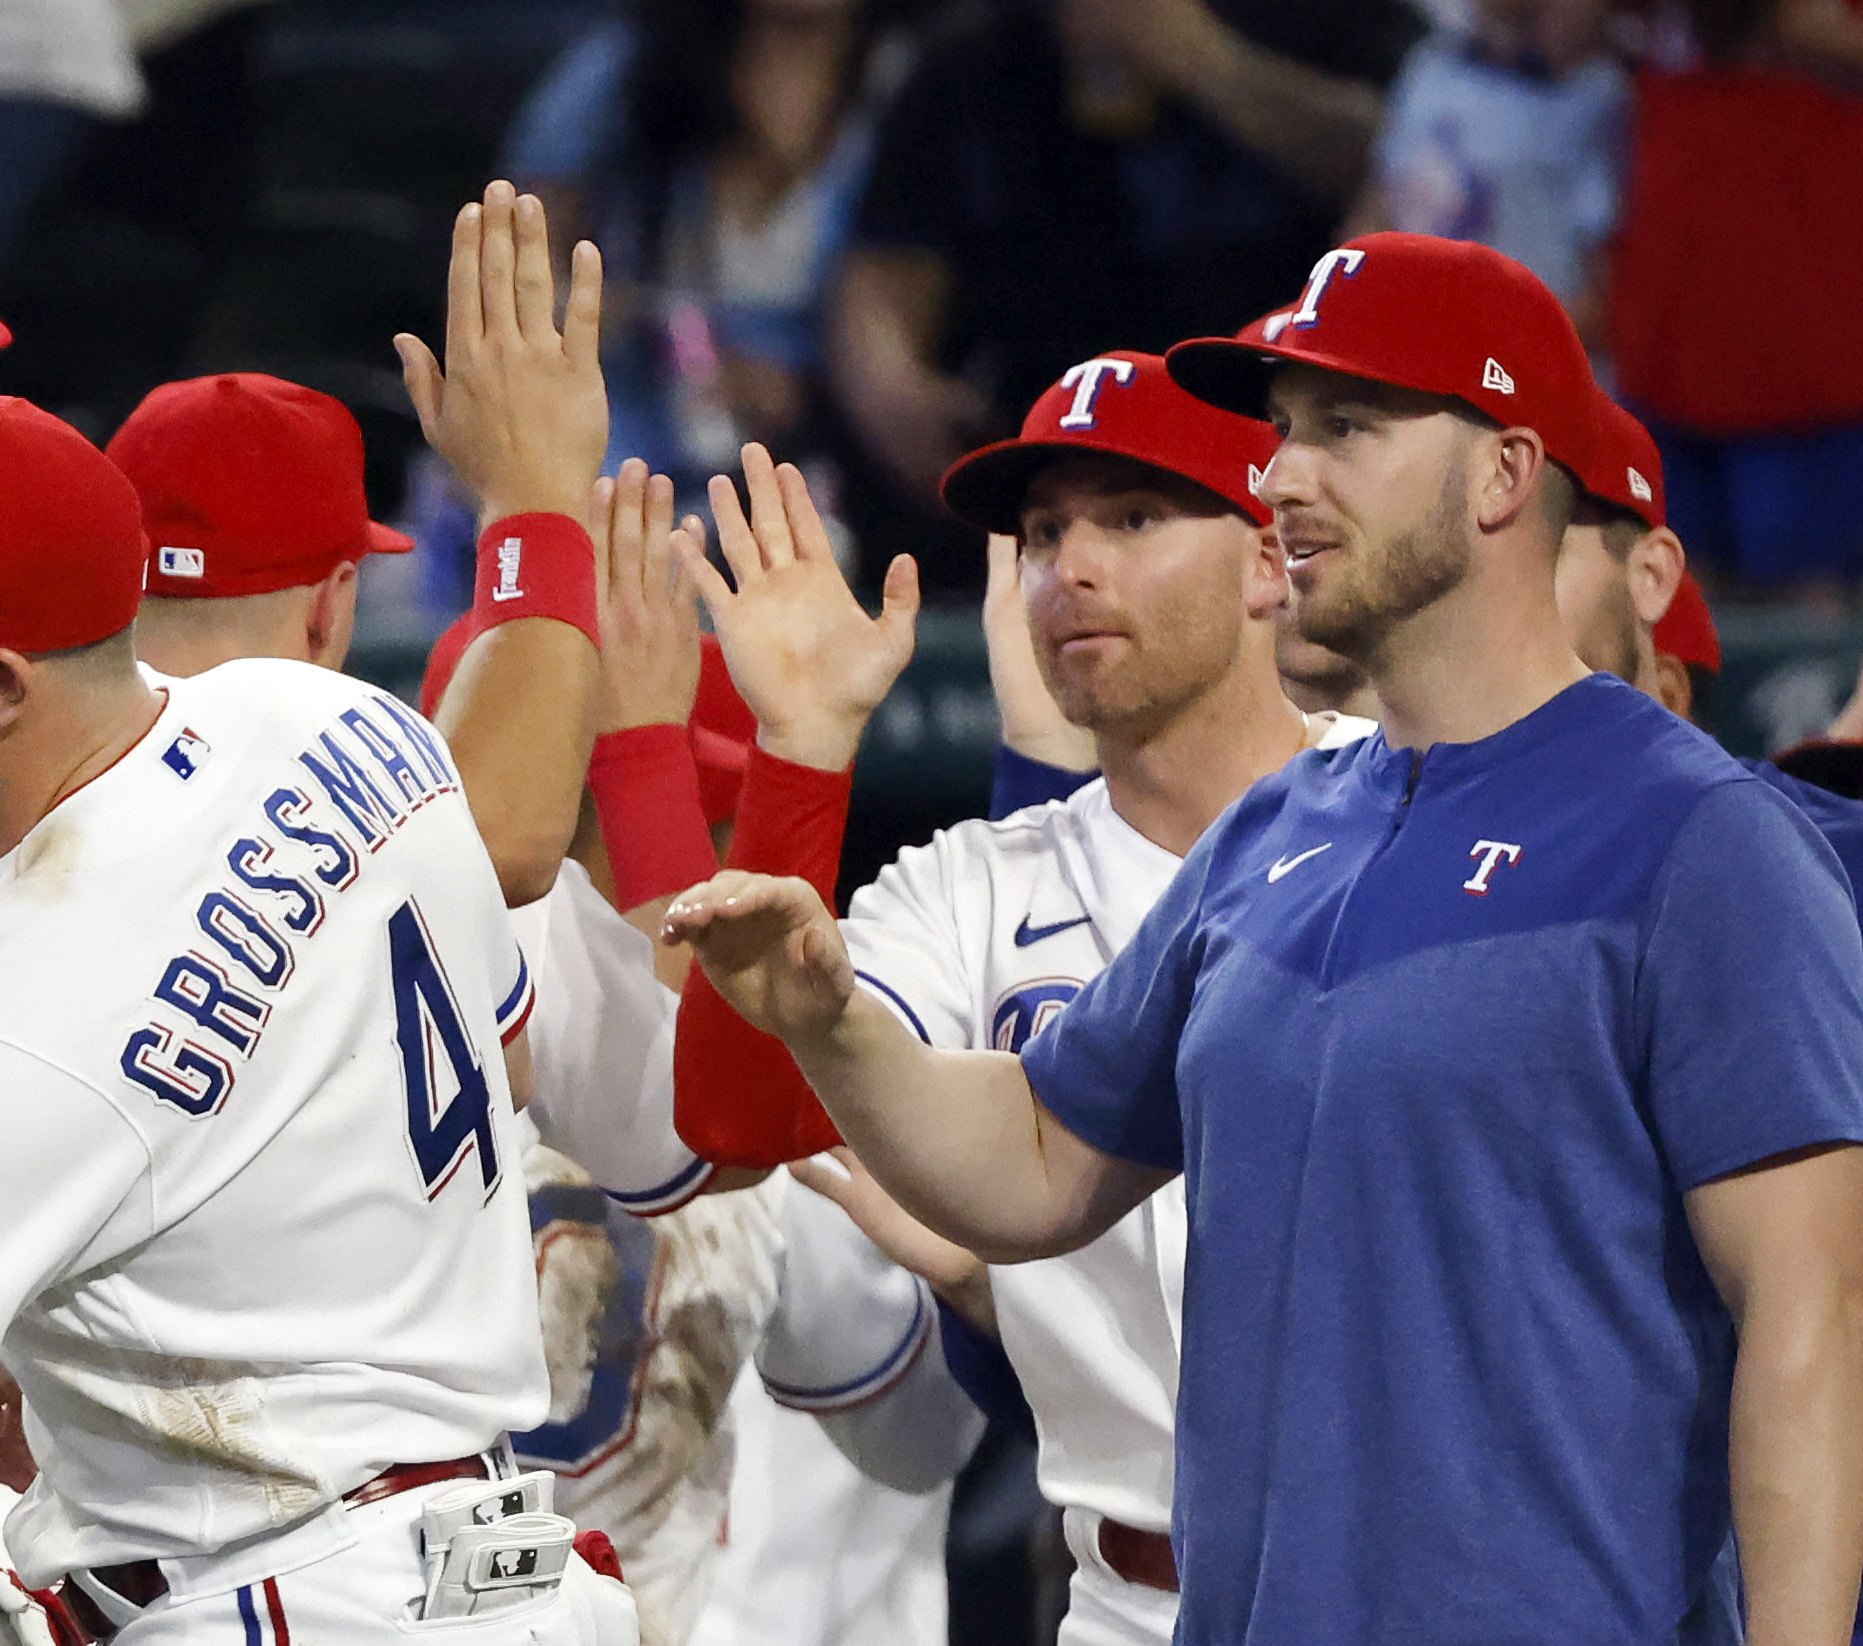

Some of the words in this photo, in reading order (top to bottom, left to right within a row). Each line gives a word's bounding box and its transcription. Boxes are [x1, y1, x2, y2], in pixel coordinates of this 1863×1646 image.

[1291, 248, 1366, 329] T
[1059, 358, 1138, 430] T
[119, 692, 459, 1120] GROSSMAN
[1463, 839, 1524, 897] T
[385, 894, 504, 1208] 4
